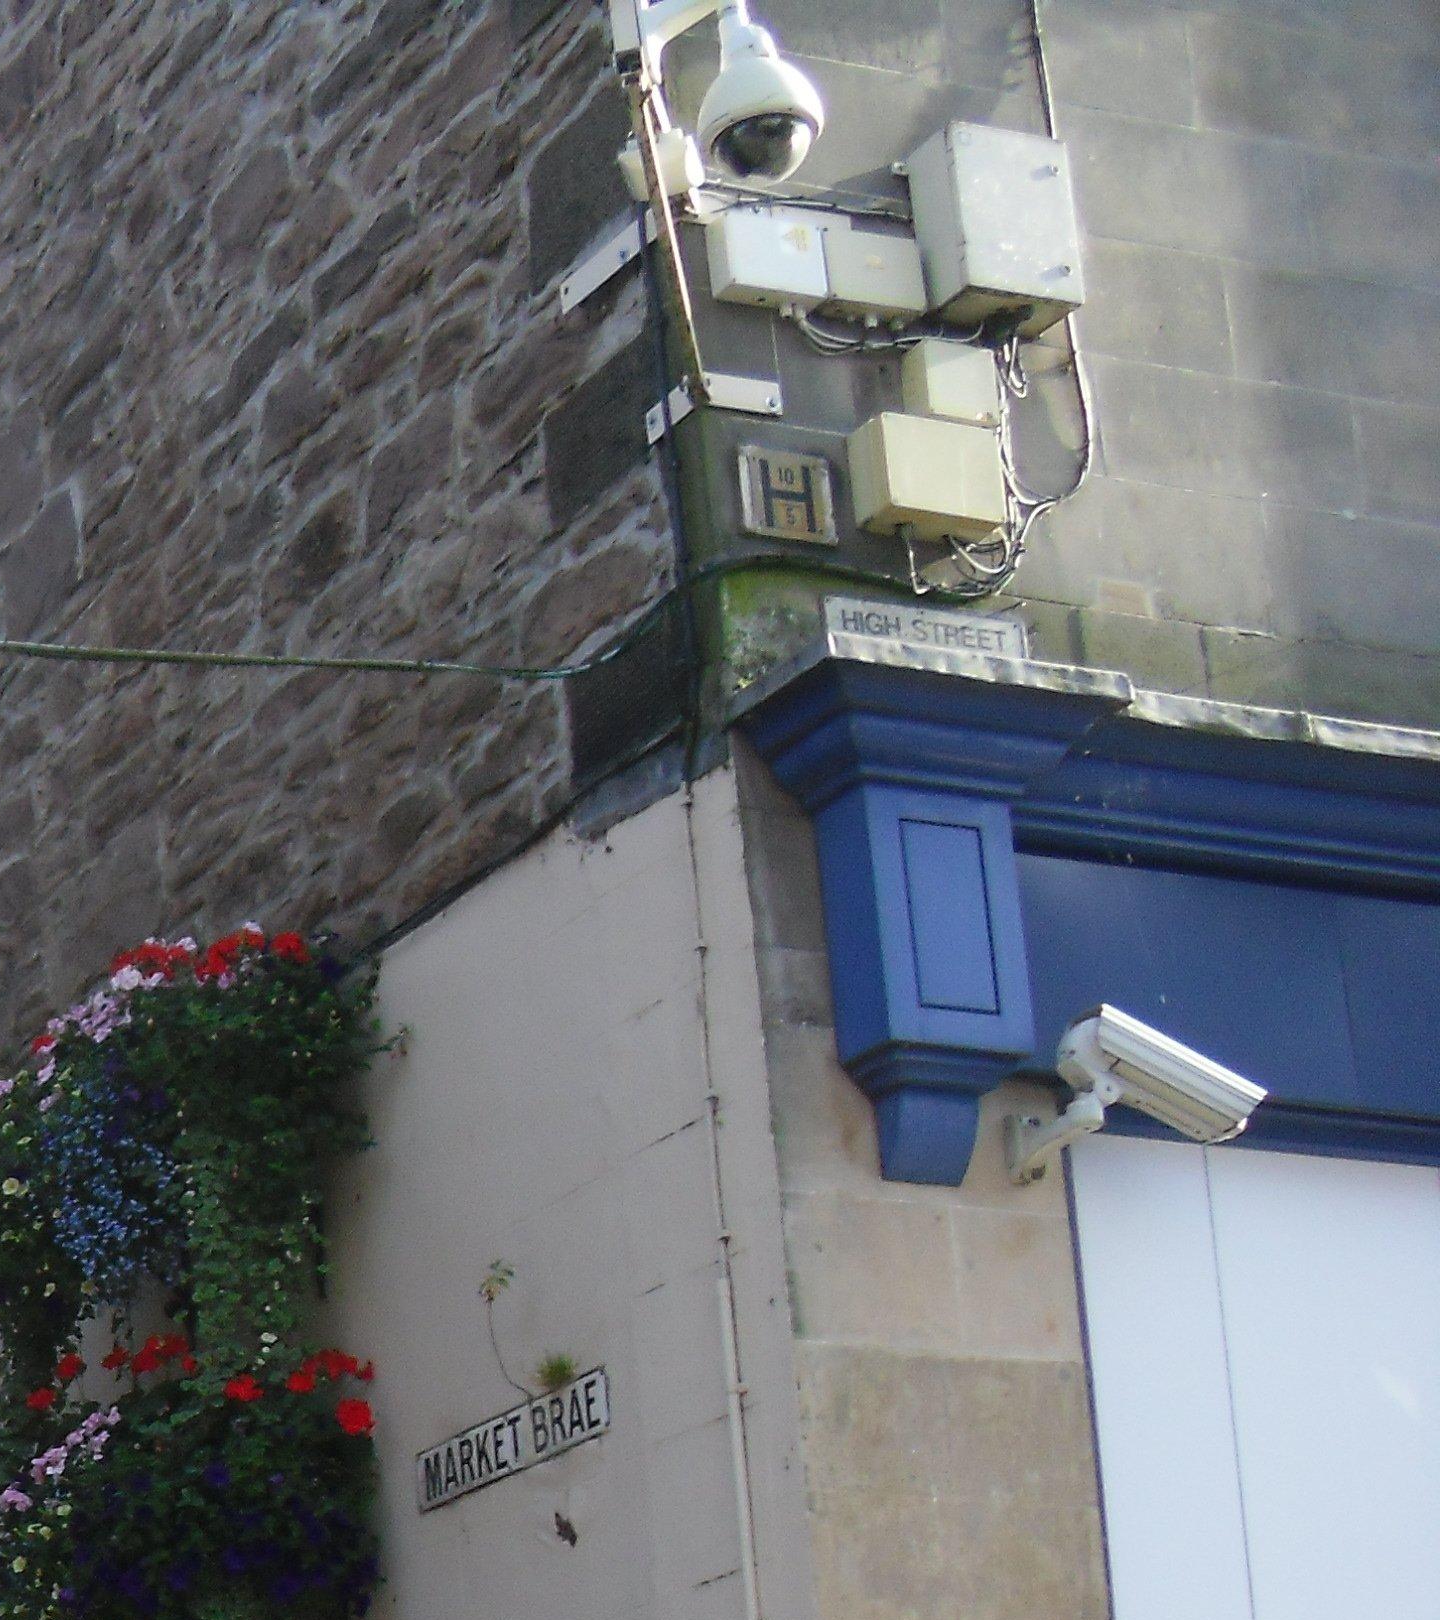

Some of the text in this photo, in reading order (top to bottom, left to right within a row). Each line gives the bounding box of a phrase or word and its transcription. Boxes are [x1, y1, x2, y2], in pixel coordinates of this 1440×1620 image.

[841, 609, 1006, 651] HIGH STREET
[424, 1380, 601, 1501] MARKET BRAE
